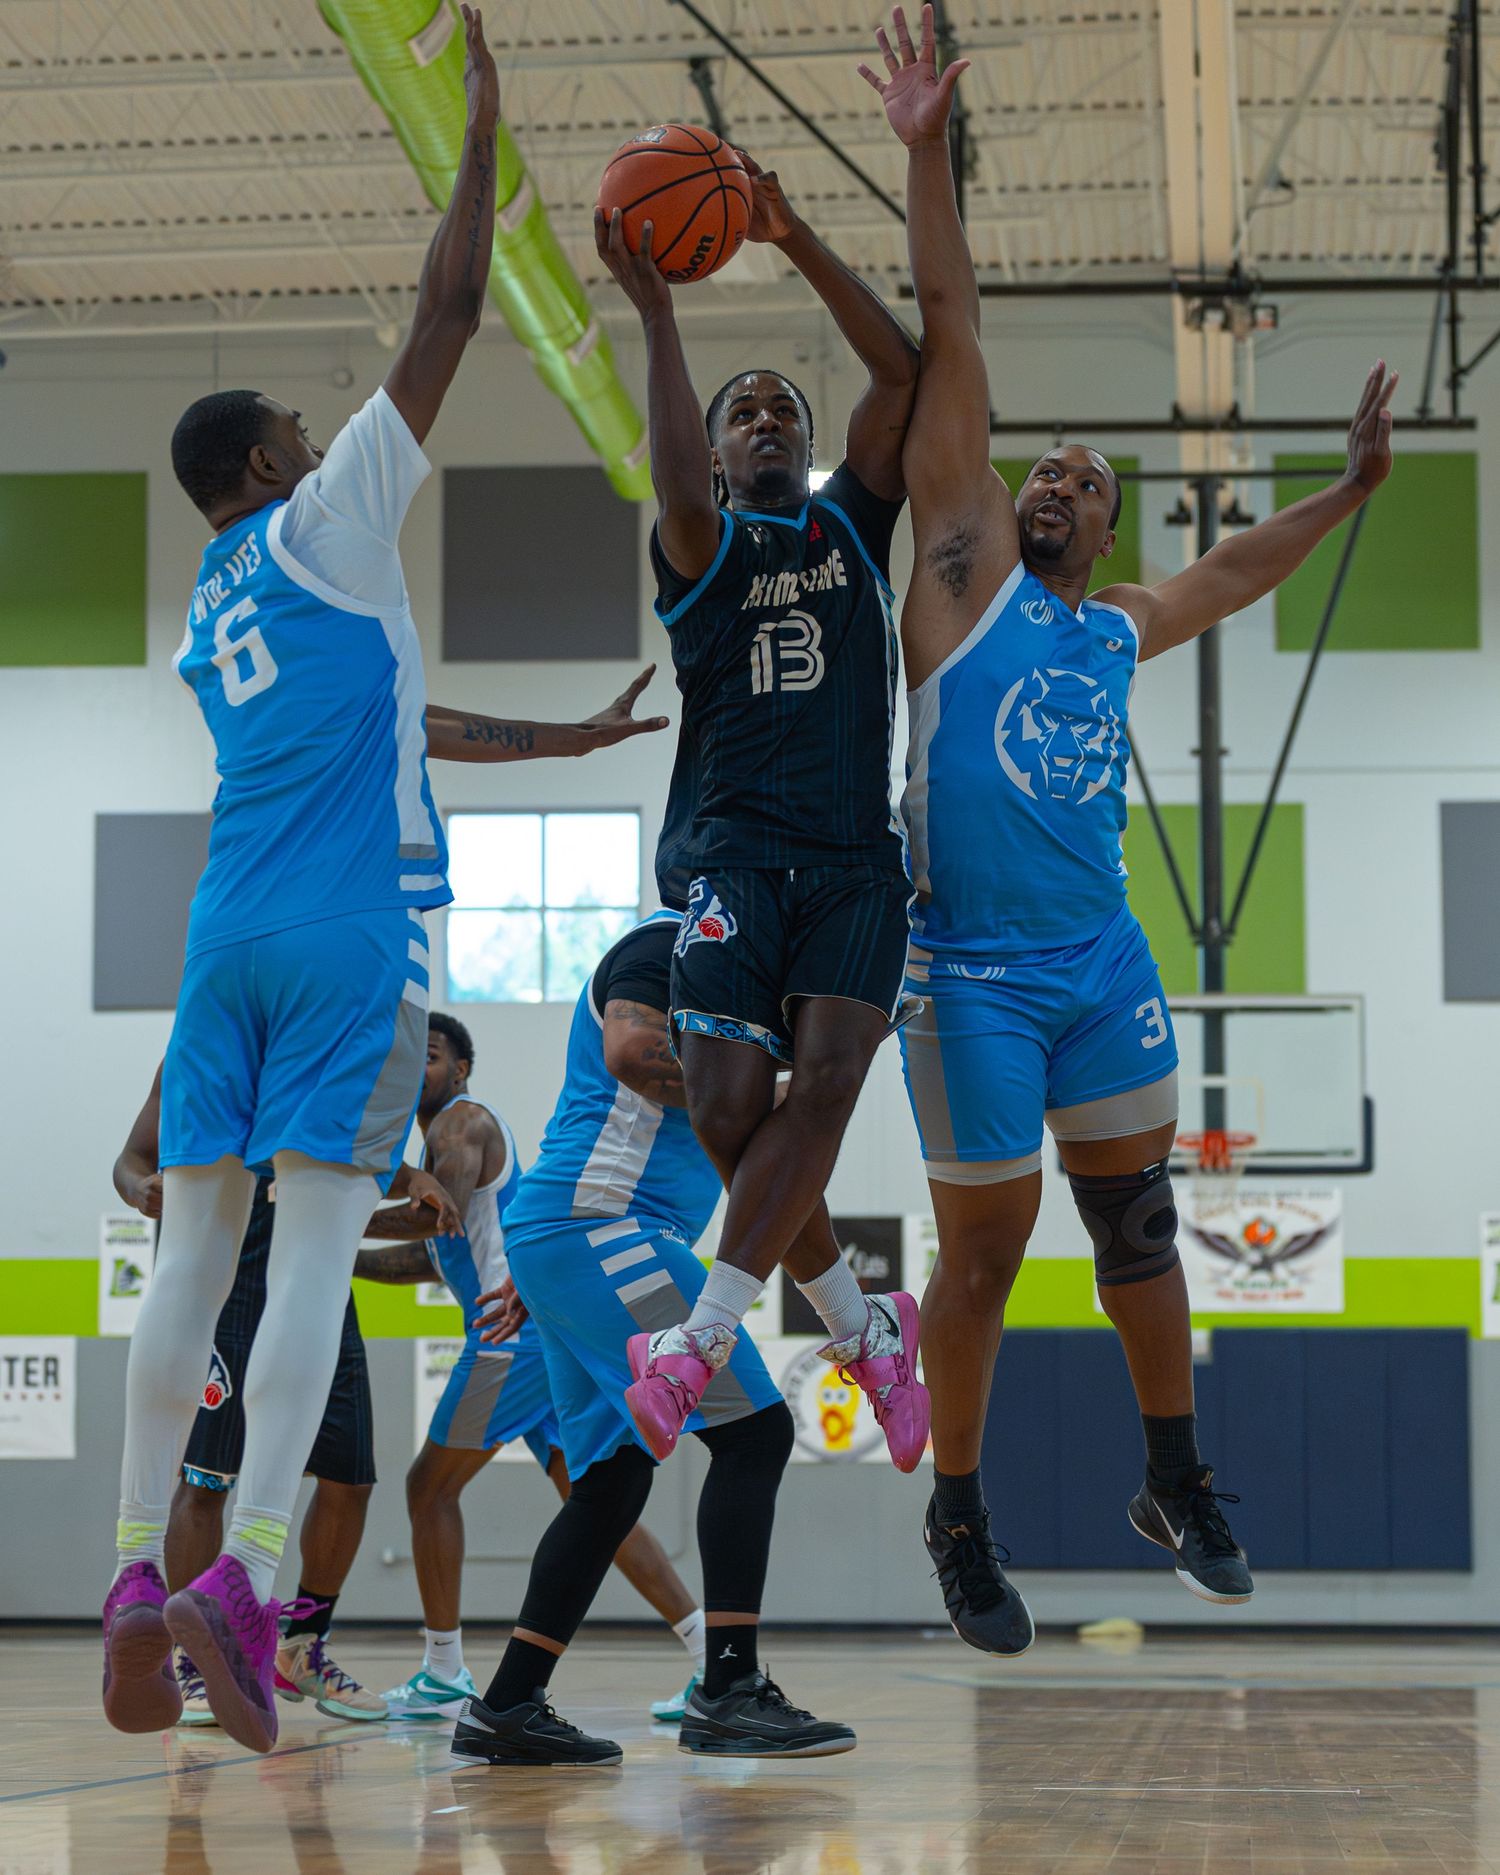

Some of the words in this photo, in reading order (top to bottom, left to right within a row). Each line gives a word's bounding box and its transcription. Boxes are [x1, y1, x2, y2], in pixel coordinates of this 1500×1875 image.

[193, 531, 262, 625] WOLVES
[211, 595, 279, 707] 6
[751, 608, 826, 696] 13
[1135, 997, 1168, 1049] 3
